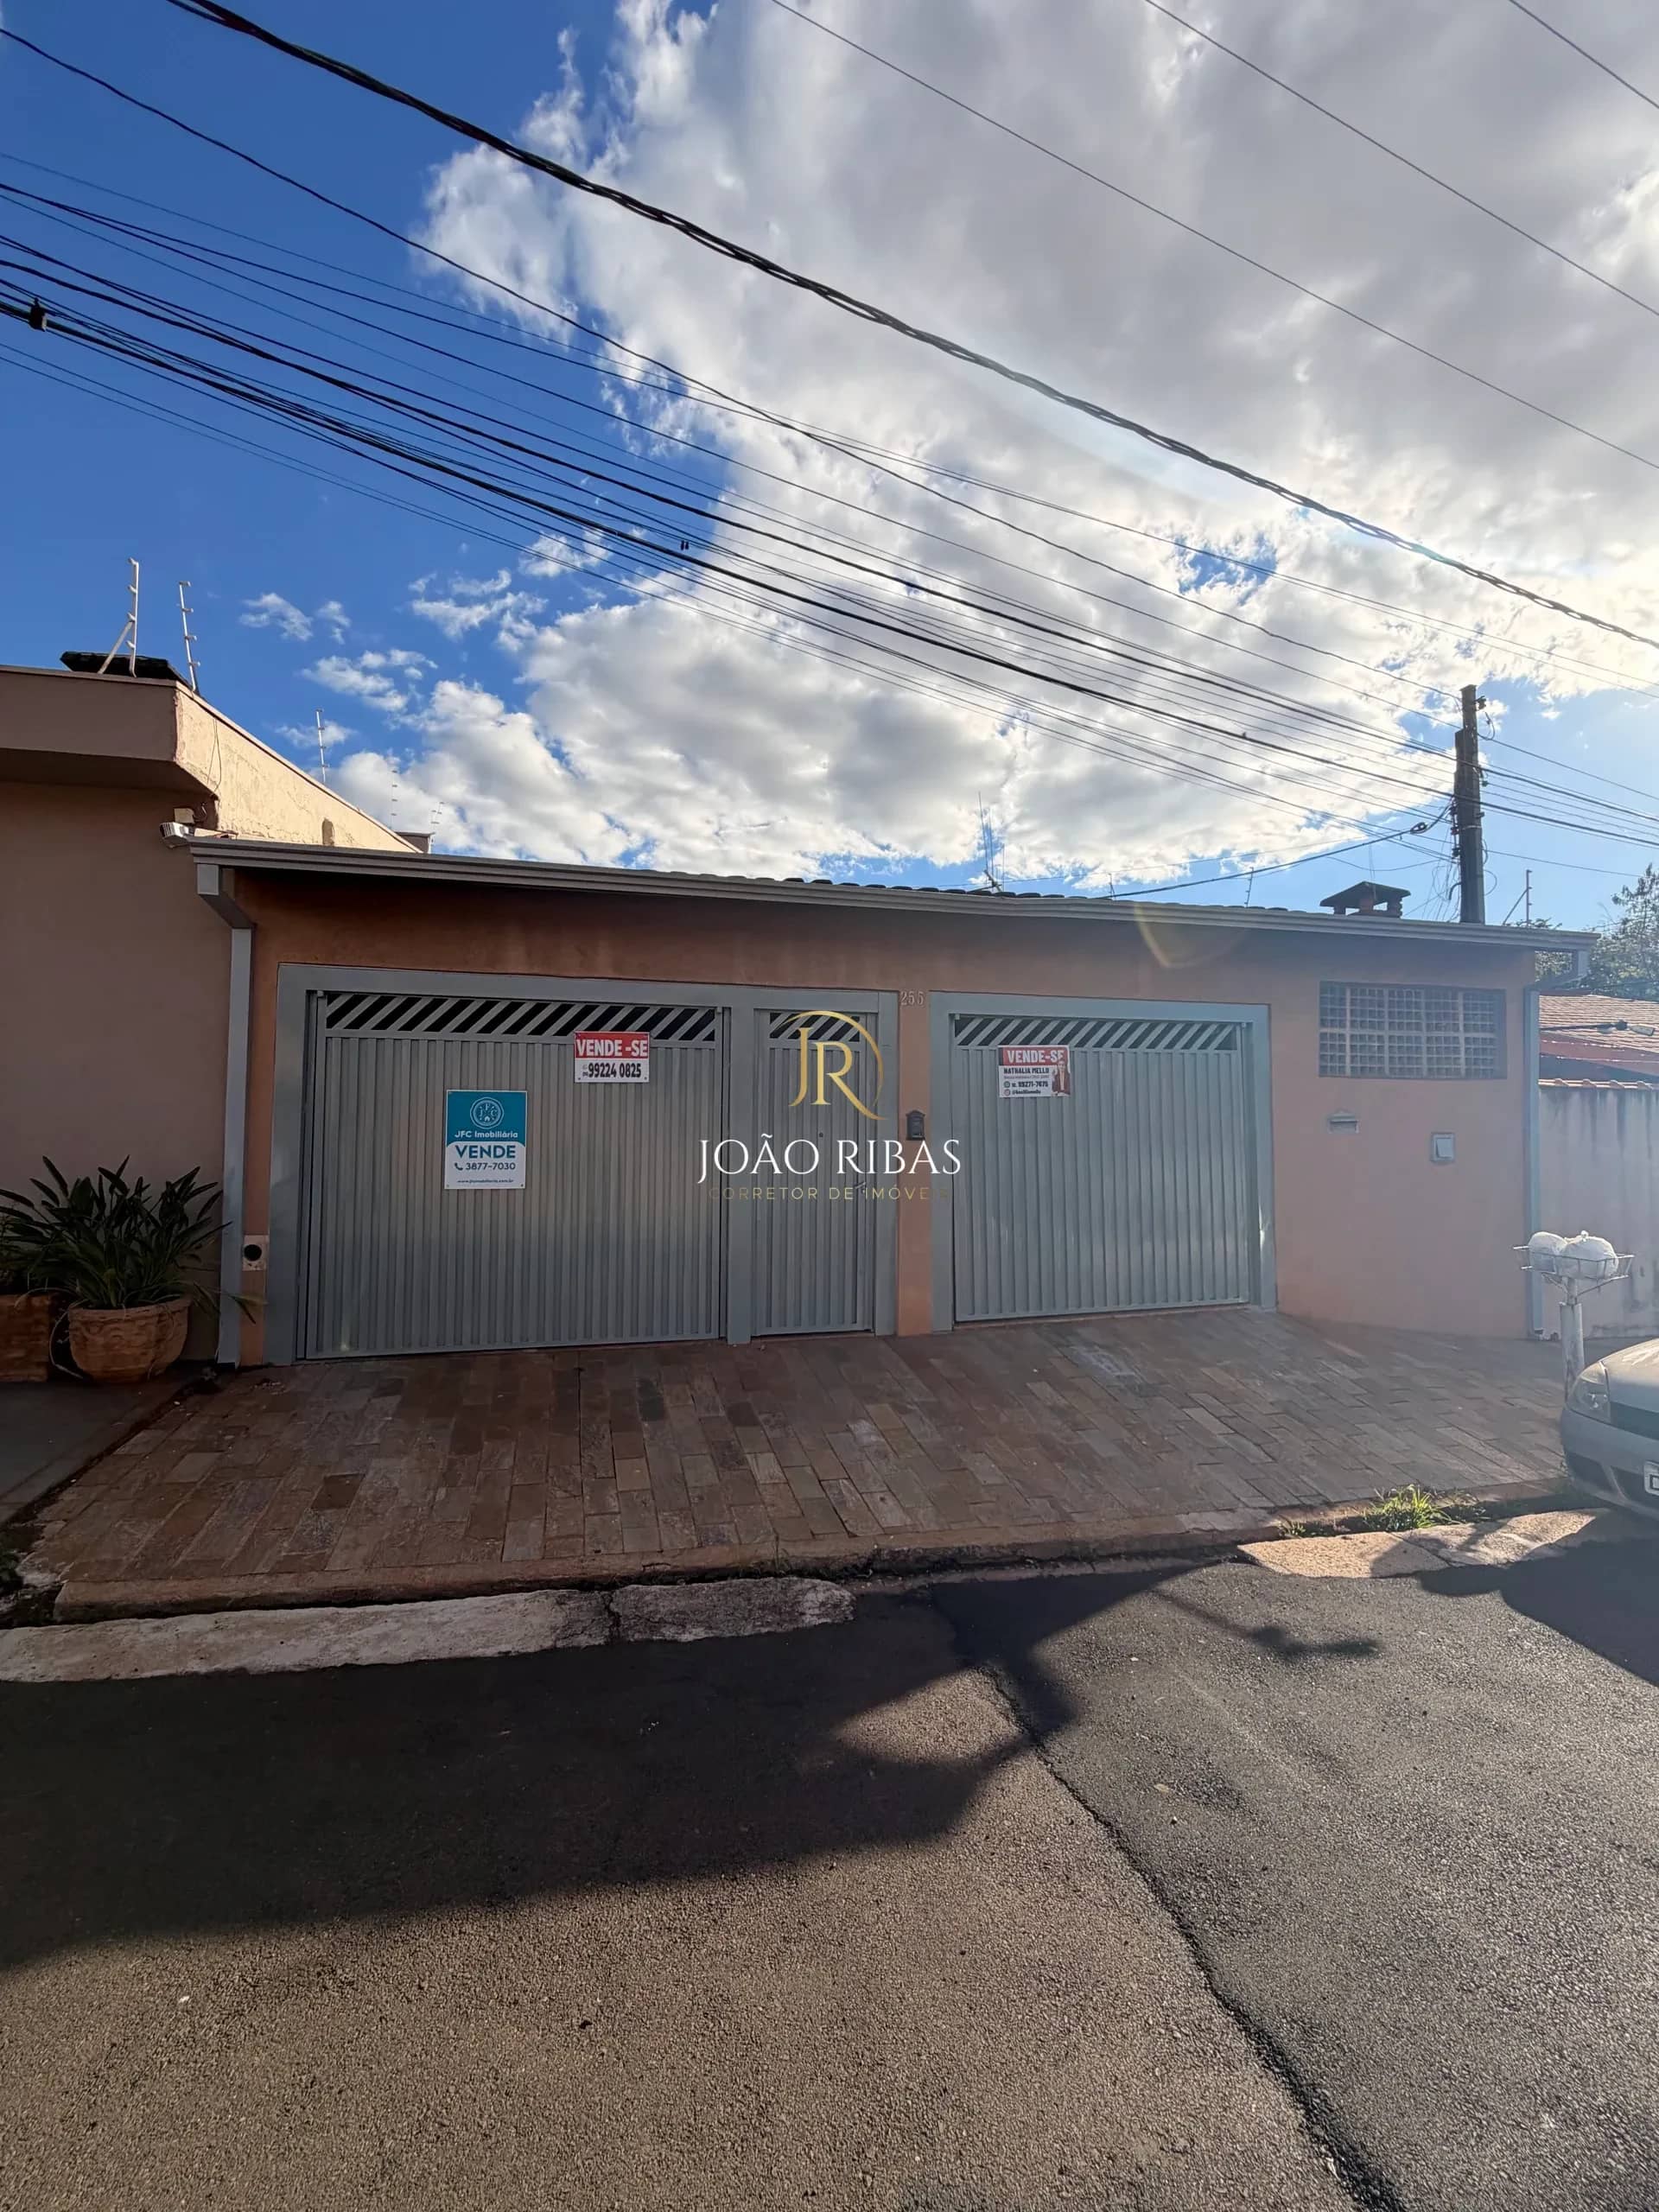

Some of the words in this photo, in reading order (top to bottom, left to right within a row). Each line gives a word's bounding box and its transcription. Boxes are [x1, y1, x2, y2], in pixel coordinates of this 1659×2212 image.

[1007, 1050, 1065, 1063] VENDE-SE
[588, 1063, 617, 1078] 99224
[619, 1063, 641, 1078] 0825
[455, 1145, 516, 1159] VENDE
[466, 1162, 516, 1171] 3877-7030
